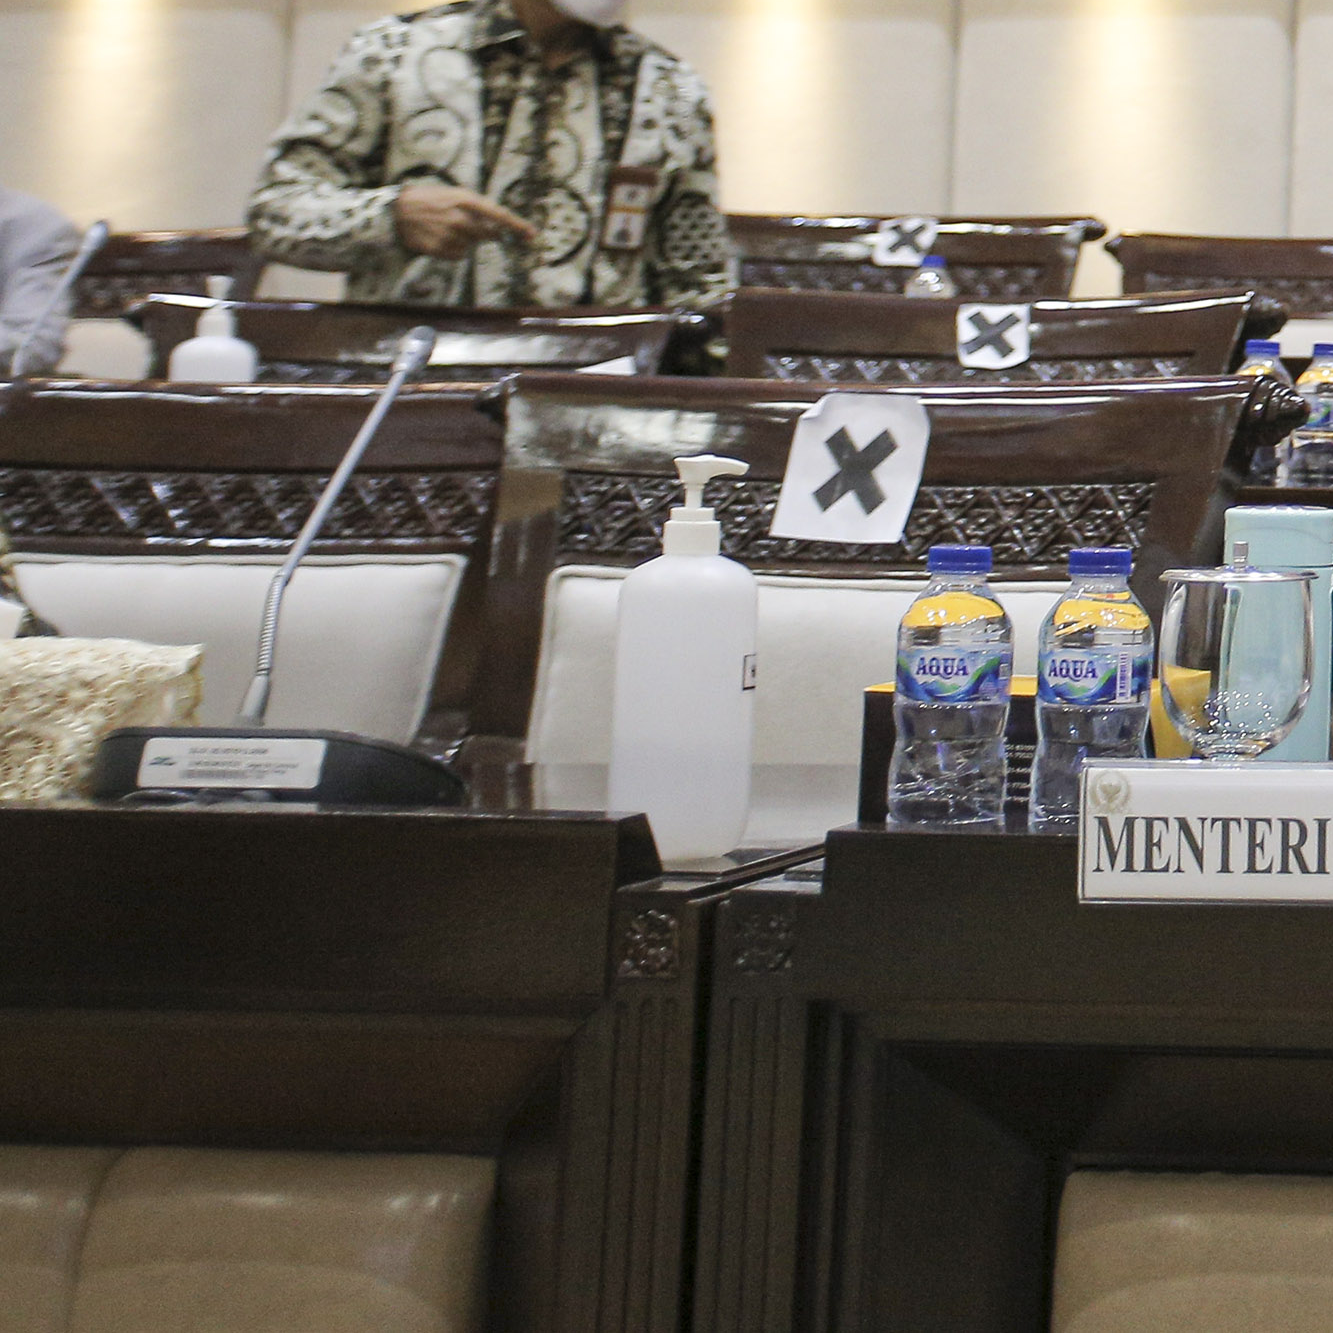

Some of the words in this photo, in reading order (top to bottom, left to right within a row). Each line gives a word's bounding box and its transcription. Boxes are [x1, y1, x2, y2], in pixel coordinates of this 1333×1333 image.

[916, 657, 969, 680] AQUA
[1048, 659, 1098, 682] AQUA
[1093, 816, 1331, 875] MENTERI
